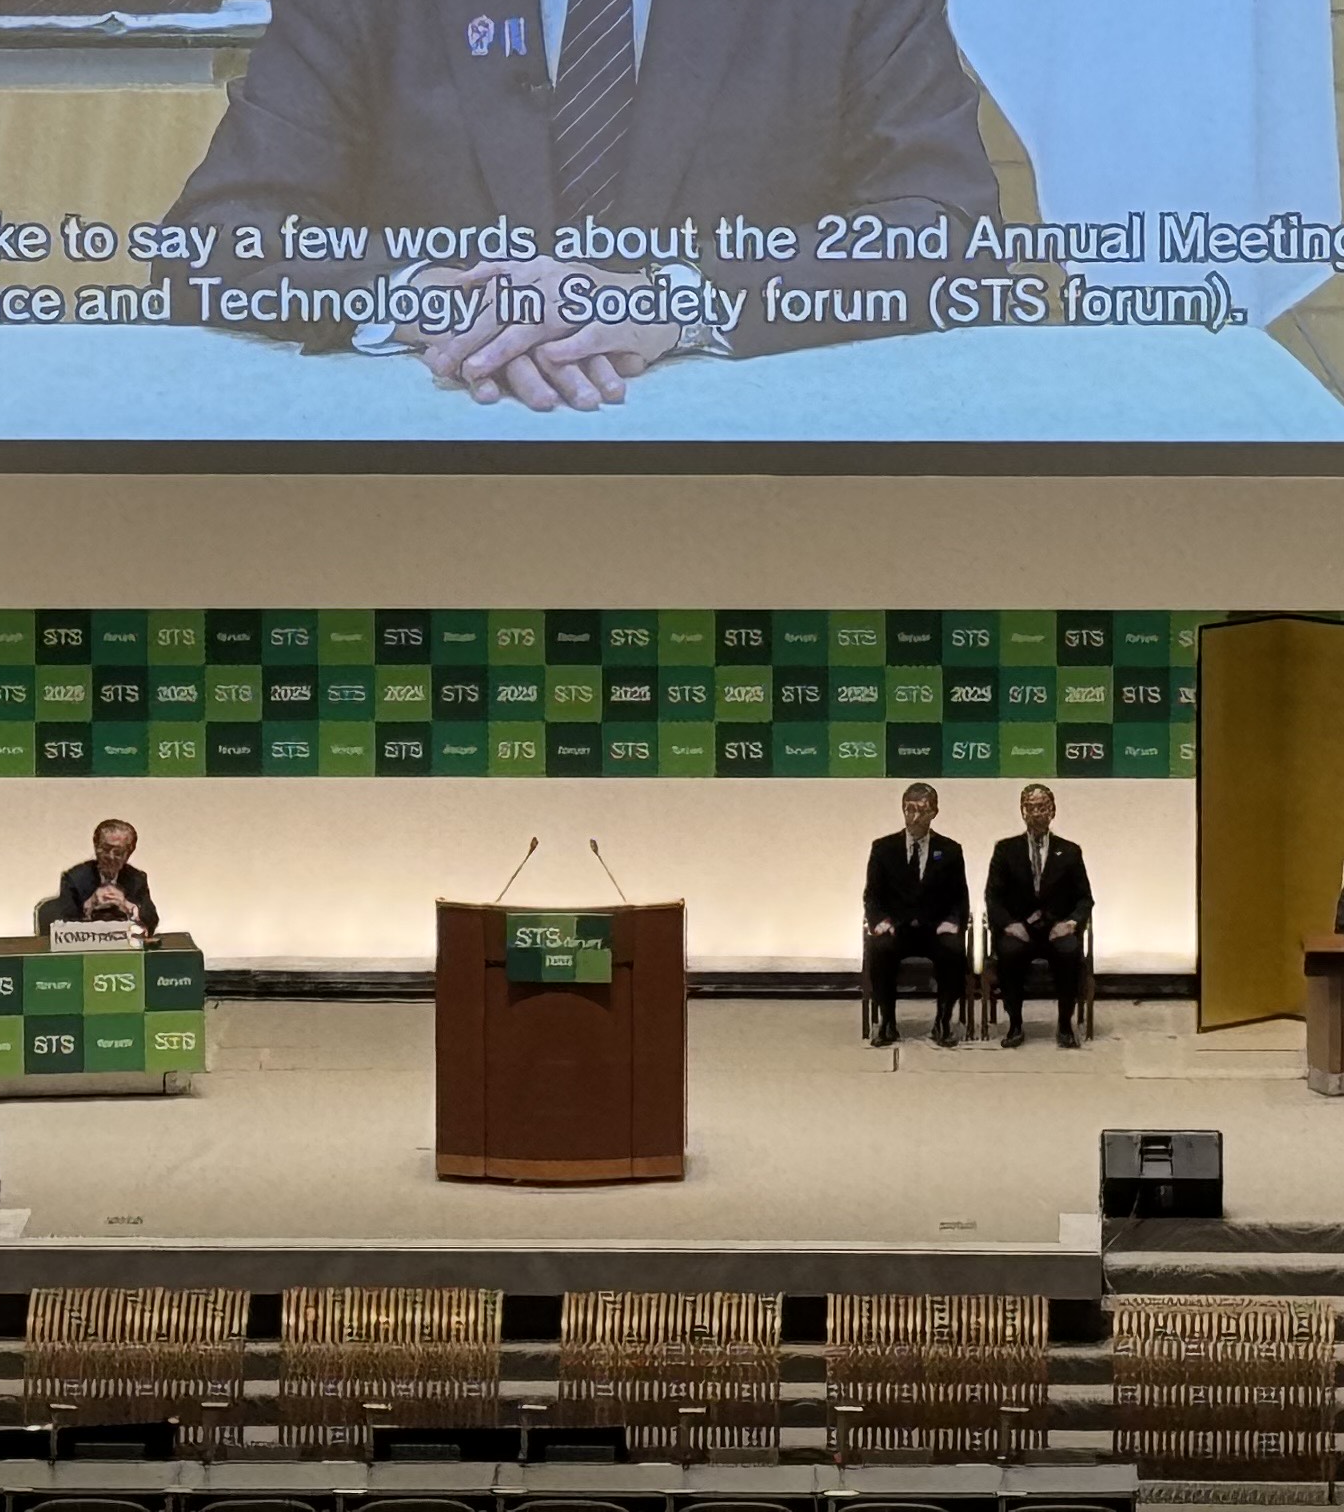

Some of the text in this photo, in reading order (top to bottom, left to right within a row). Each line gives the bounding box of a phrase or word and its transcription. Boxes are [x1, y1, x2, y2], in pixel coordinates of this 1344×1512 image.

[65, 216, 117, 259] to
[130, 223, 216, 269] say
[233, 225, 263, 259] a
[281, 215, 368, 259] few
[386, 216, 537, 259] words
[555, 216, 698, 259] about
[716, 216, 796, 259] the
[816, 215, 947, 259] 22nd
[966, 213, 1144, 259] Annual
[76, 276, 170, 322] and
[189, 276, 480, 331] Technology
[497, 276, 542, 322] in
[559, 276, 747, 331] Society
[765, 276, 907, 322] forum
[929, 275, 1046, 331] (STS
[1063, 274, 1247, 332] forum).
[43, 628, 83, 646] STS
[270, 627, 310, 646] STS
[383, 628, 423, 646] STS
[496, 627, 536, 647] STS
[610, 628, 650, 647] STS
[724, 628, 763, 647] STS
[951, 629, 990, 647] STS
[1065, 629, 1104, 647] STS
[100, 684, 140, 703] STS
[214, 684, 253, 703] STS
[441, 684, 479, 703] STS
[554, 685, 593, 703] STS
[781, 685, 821, 705] STS
[1122, 685, 1162, 704] STS
[44, 741, 84, 759] STS
[158, 740, 196, 760] STS
[610, 742, 650, 760] STS
[724, 741, 764, 760] STS
[515, 926, 564, 949] STS
[93, 973, 136, 992] STS
[33, 1034, 75, 1055] STS
